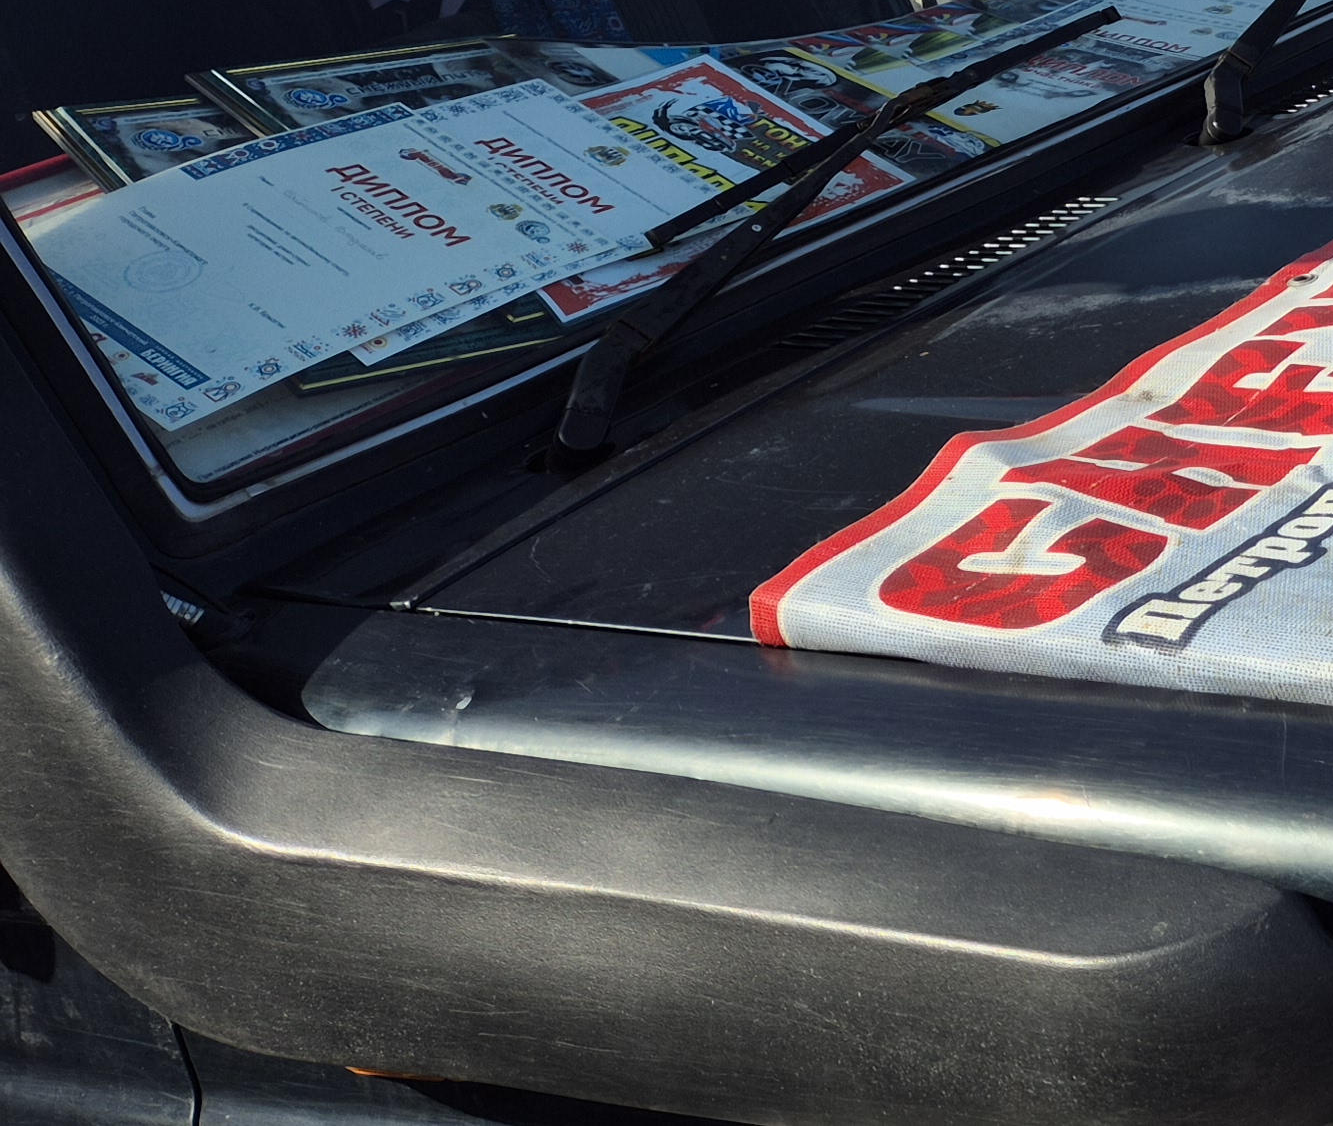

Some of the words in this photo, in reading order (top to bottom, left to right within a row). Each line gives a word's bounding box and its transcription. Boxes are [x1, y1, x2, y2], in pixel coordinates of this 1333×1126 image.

[325, 163, 471, 248] ДИПЛОМ
[474, 136, 615, 215] ДИПЛОМ
[340, 191, 416, 240] СТЕПЕНИ
[139, 346, 200, 389] БЕРИНГИЯ
